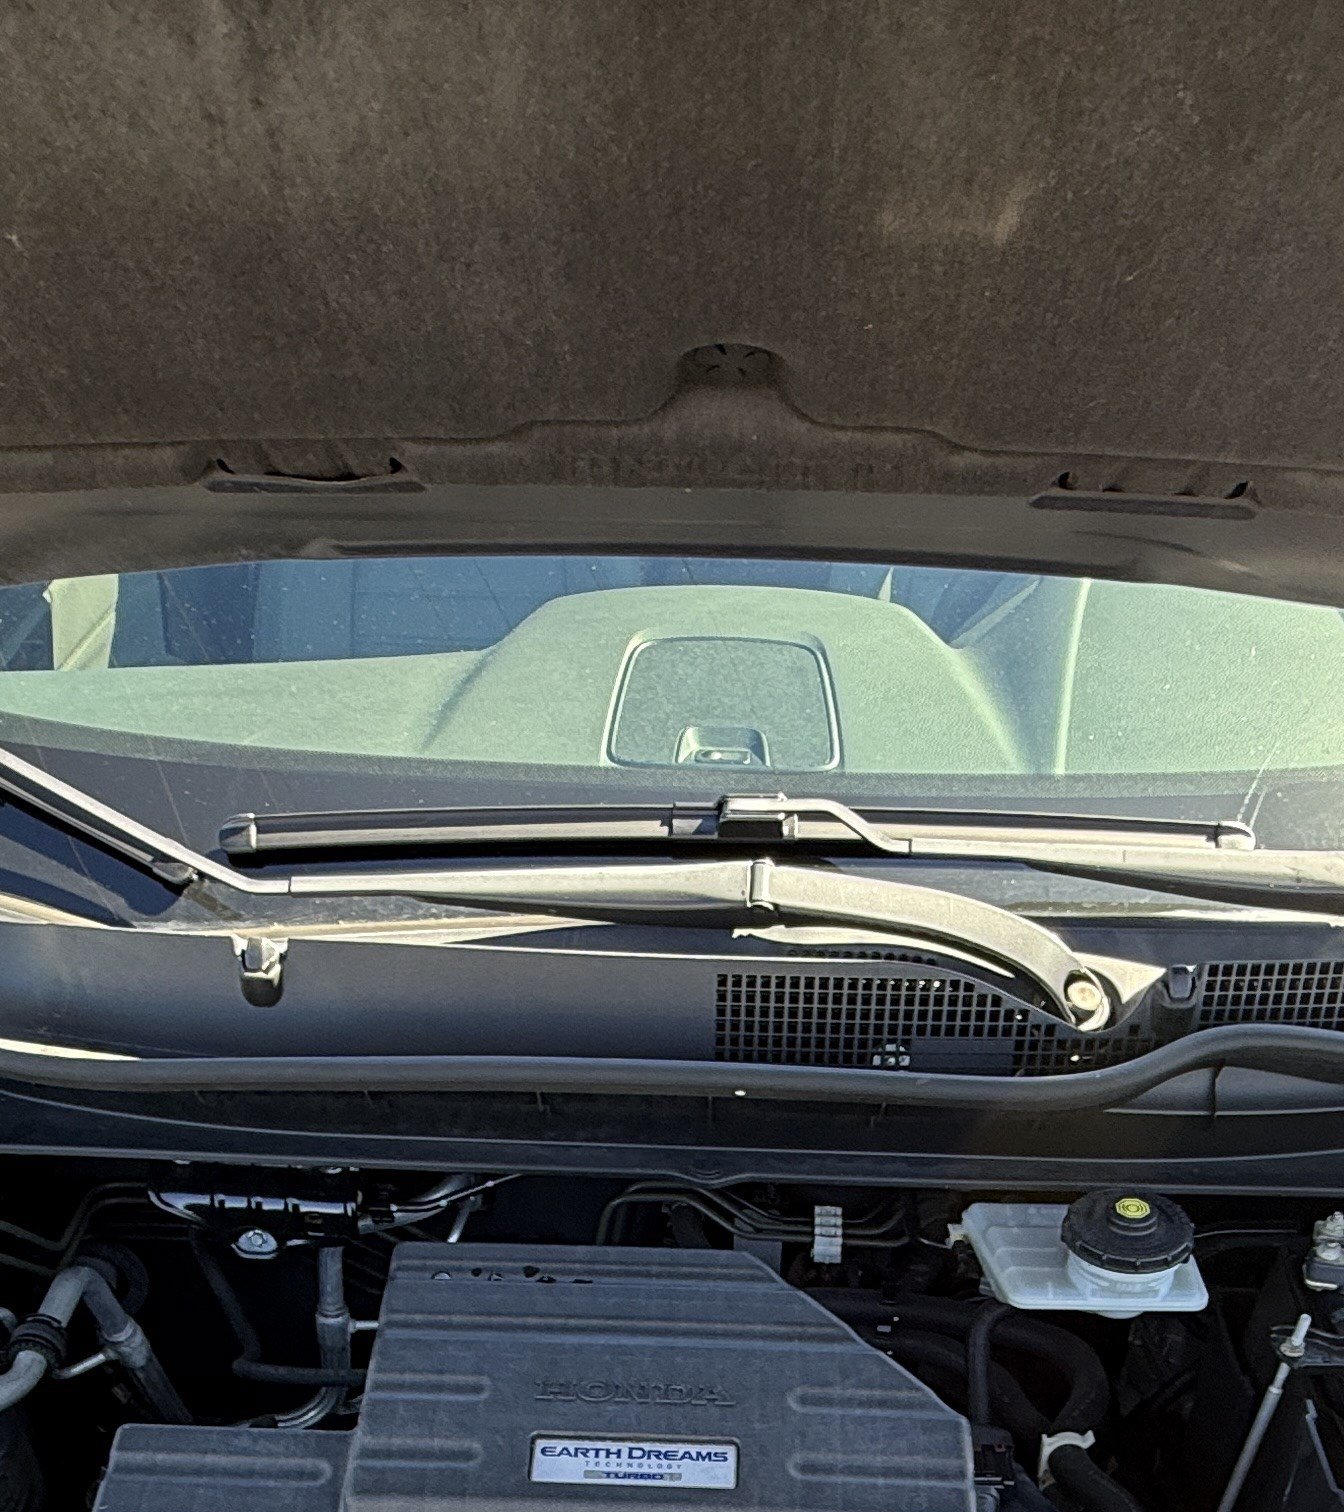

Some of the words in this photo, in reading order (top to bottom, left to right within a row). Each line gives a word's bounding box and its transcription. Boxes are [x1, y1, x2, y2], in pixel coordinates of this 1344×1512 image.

[534, 1380, 737, 1407] HONDA
[540, 1446, 622, 1460] EARTH
[628, 1447, 729, 1462] DREAMS
[584, 1461, 683, 1470] TECHNOLOGY
[602, 1471, 665, 1480] TURBO
